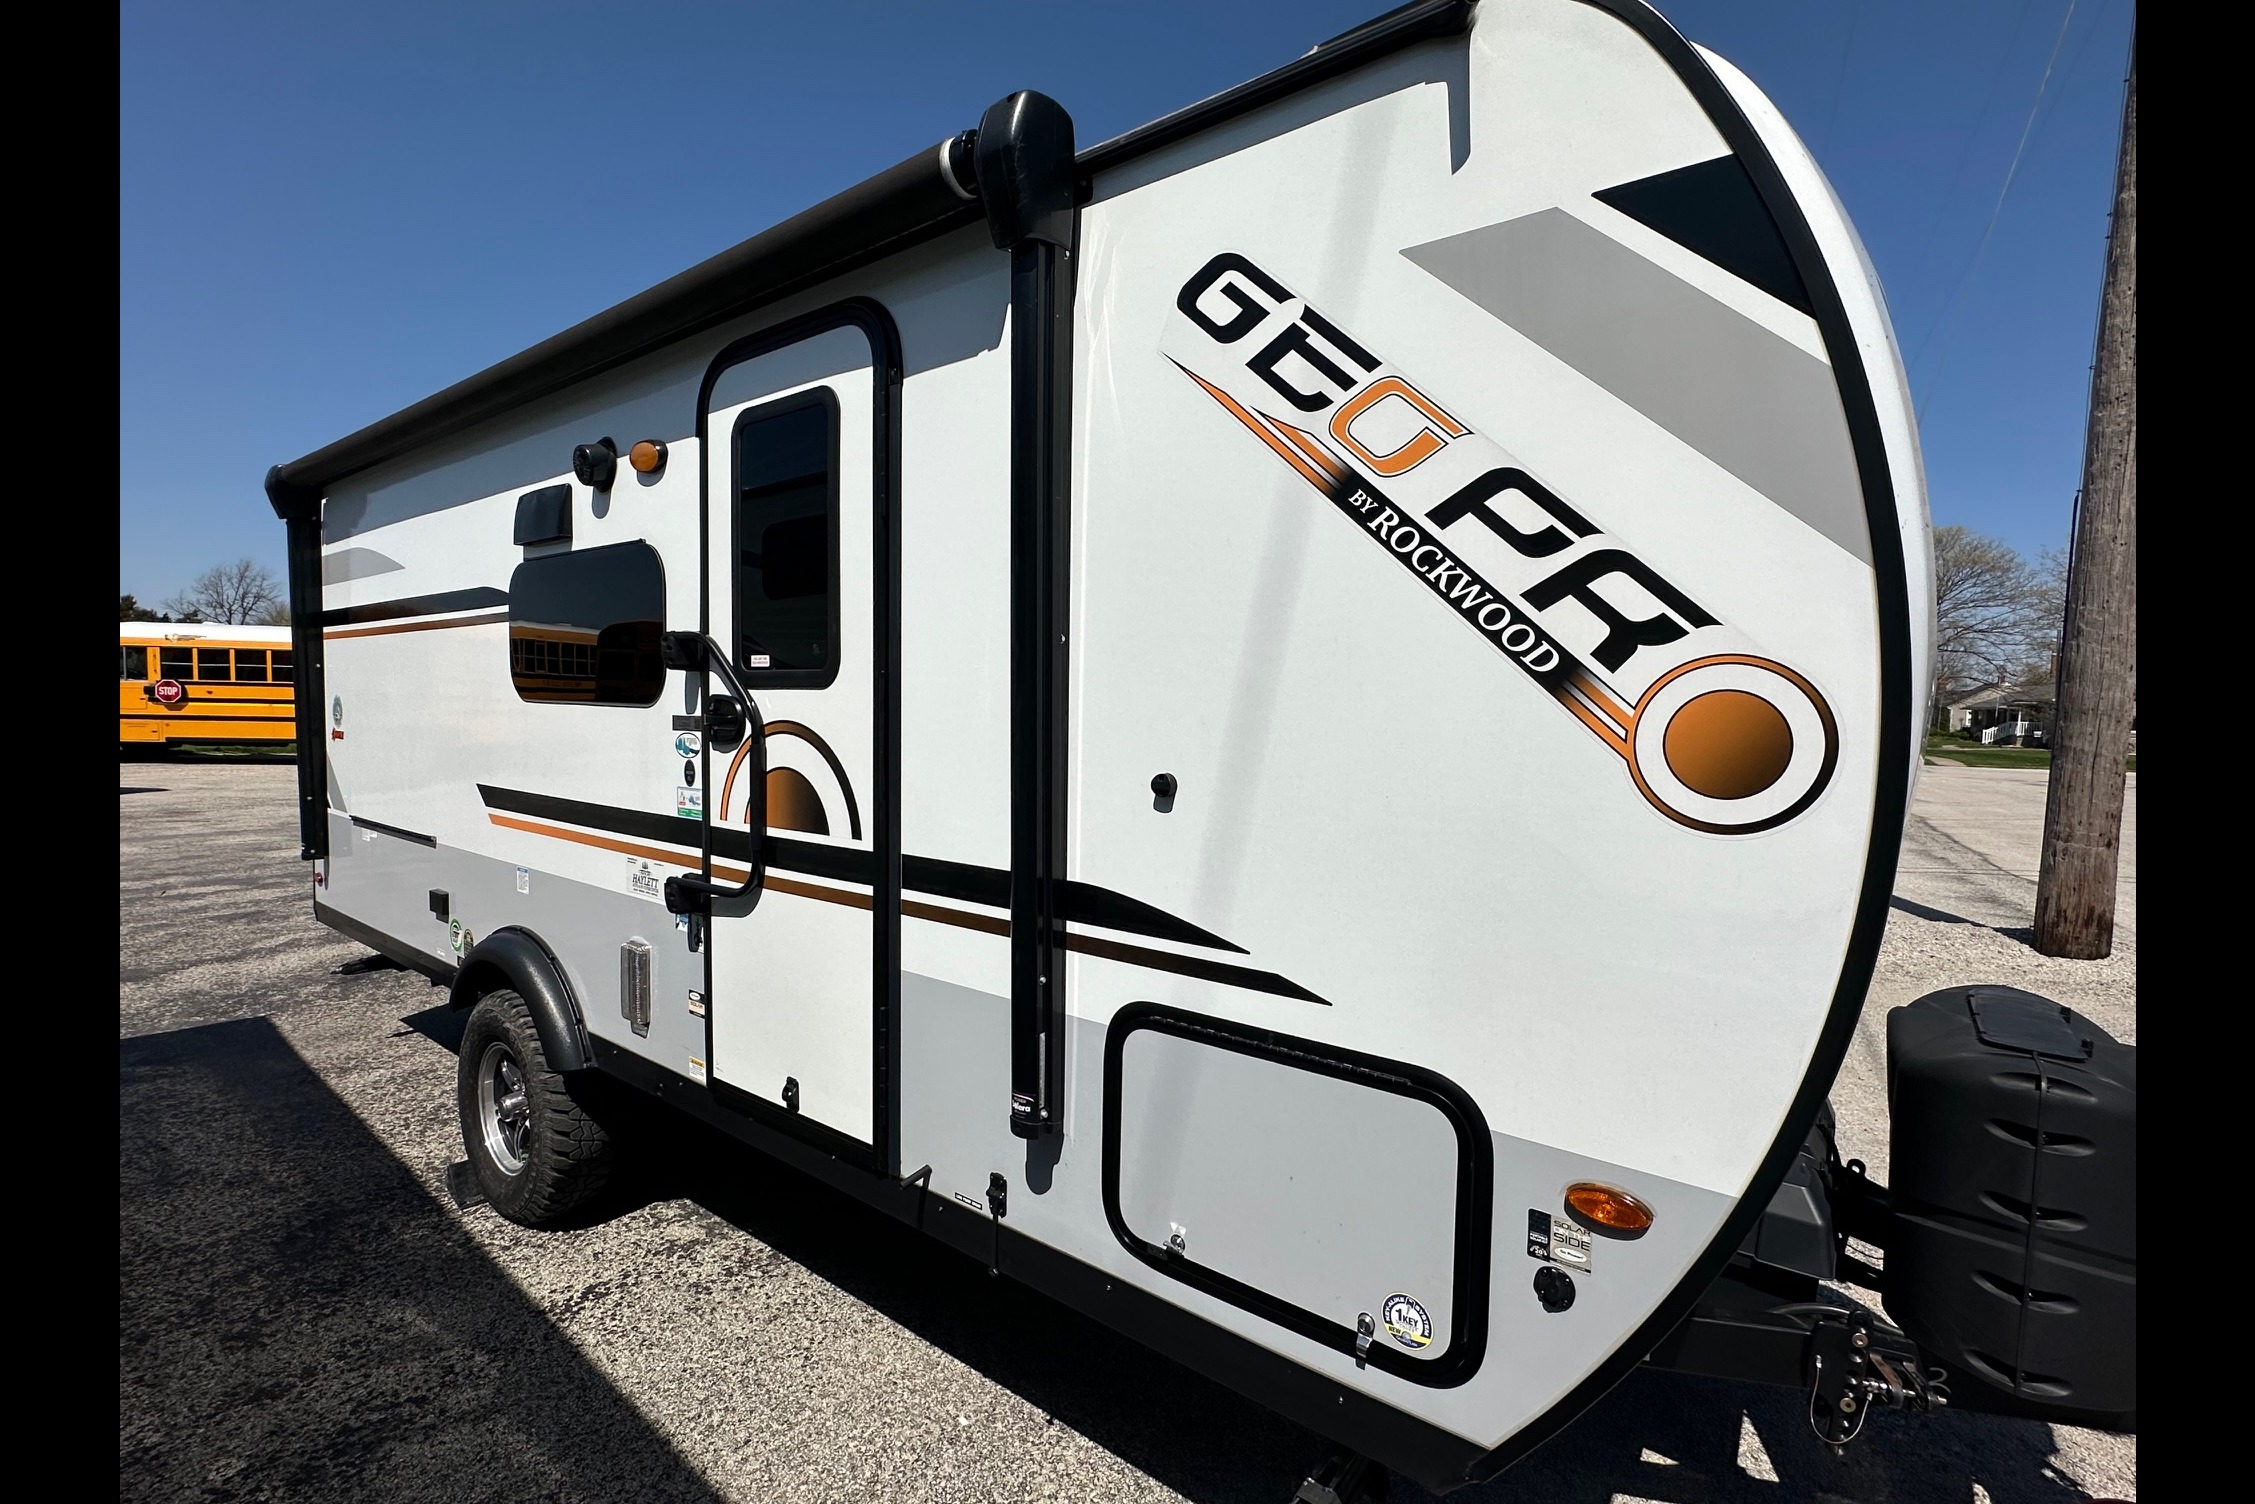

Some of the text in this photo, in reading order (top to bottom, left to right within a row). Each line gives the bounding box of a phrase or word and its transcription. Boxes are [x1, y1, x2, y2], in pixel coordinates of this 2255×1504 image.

[1348, 488, 1560, 673] BY ROCKWOOD
[159, 686, 178, 696] STOP
[632, 873, 659, 889] HAYLETT
[1554, 1220, 1591, 1237] SOLAR
[1553, 1232, 1591, 1251] SIDE
